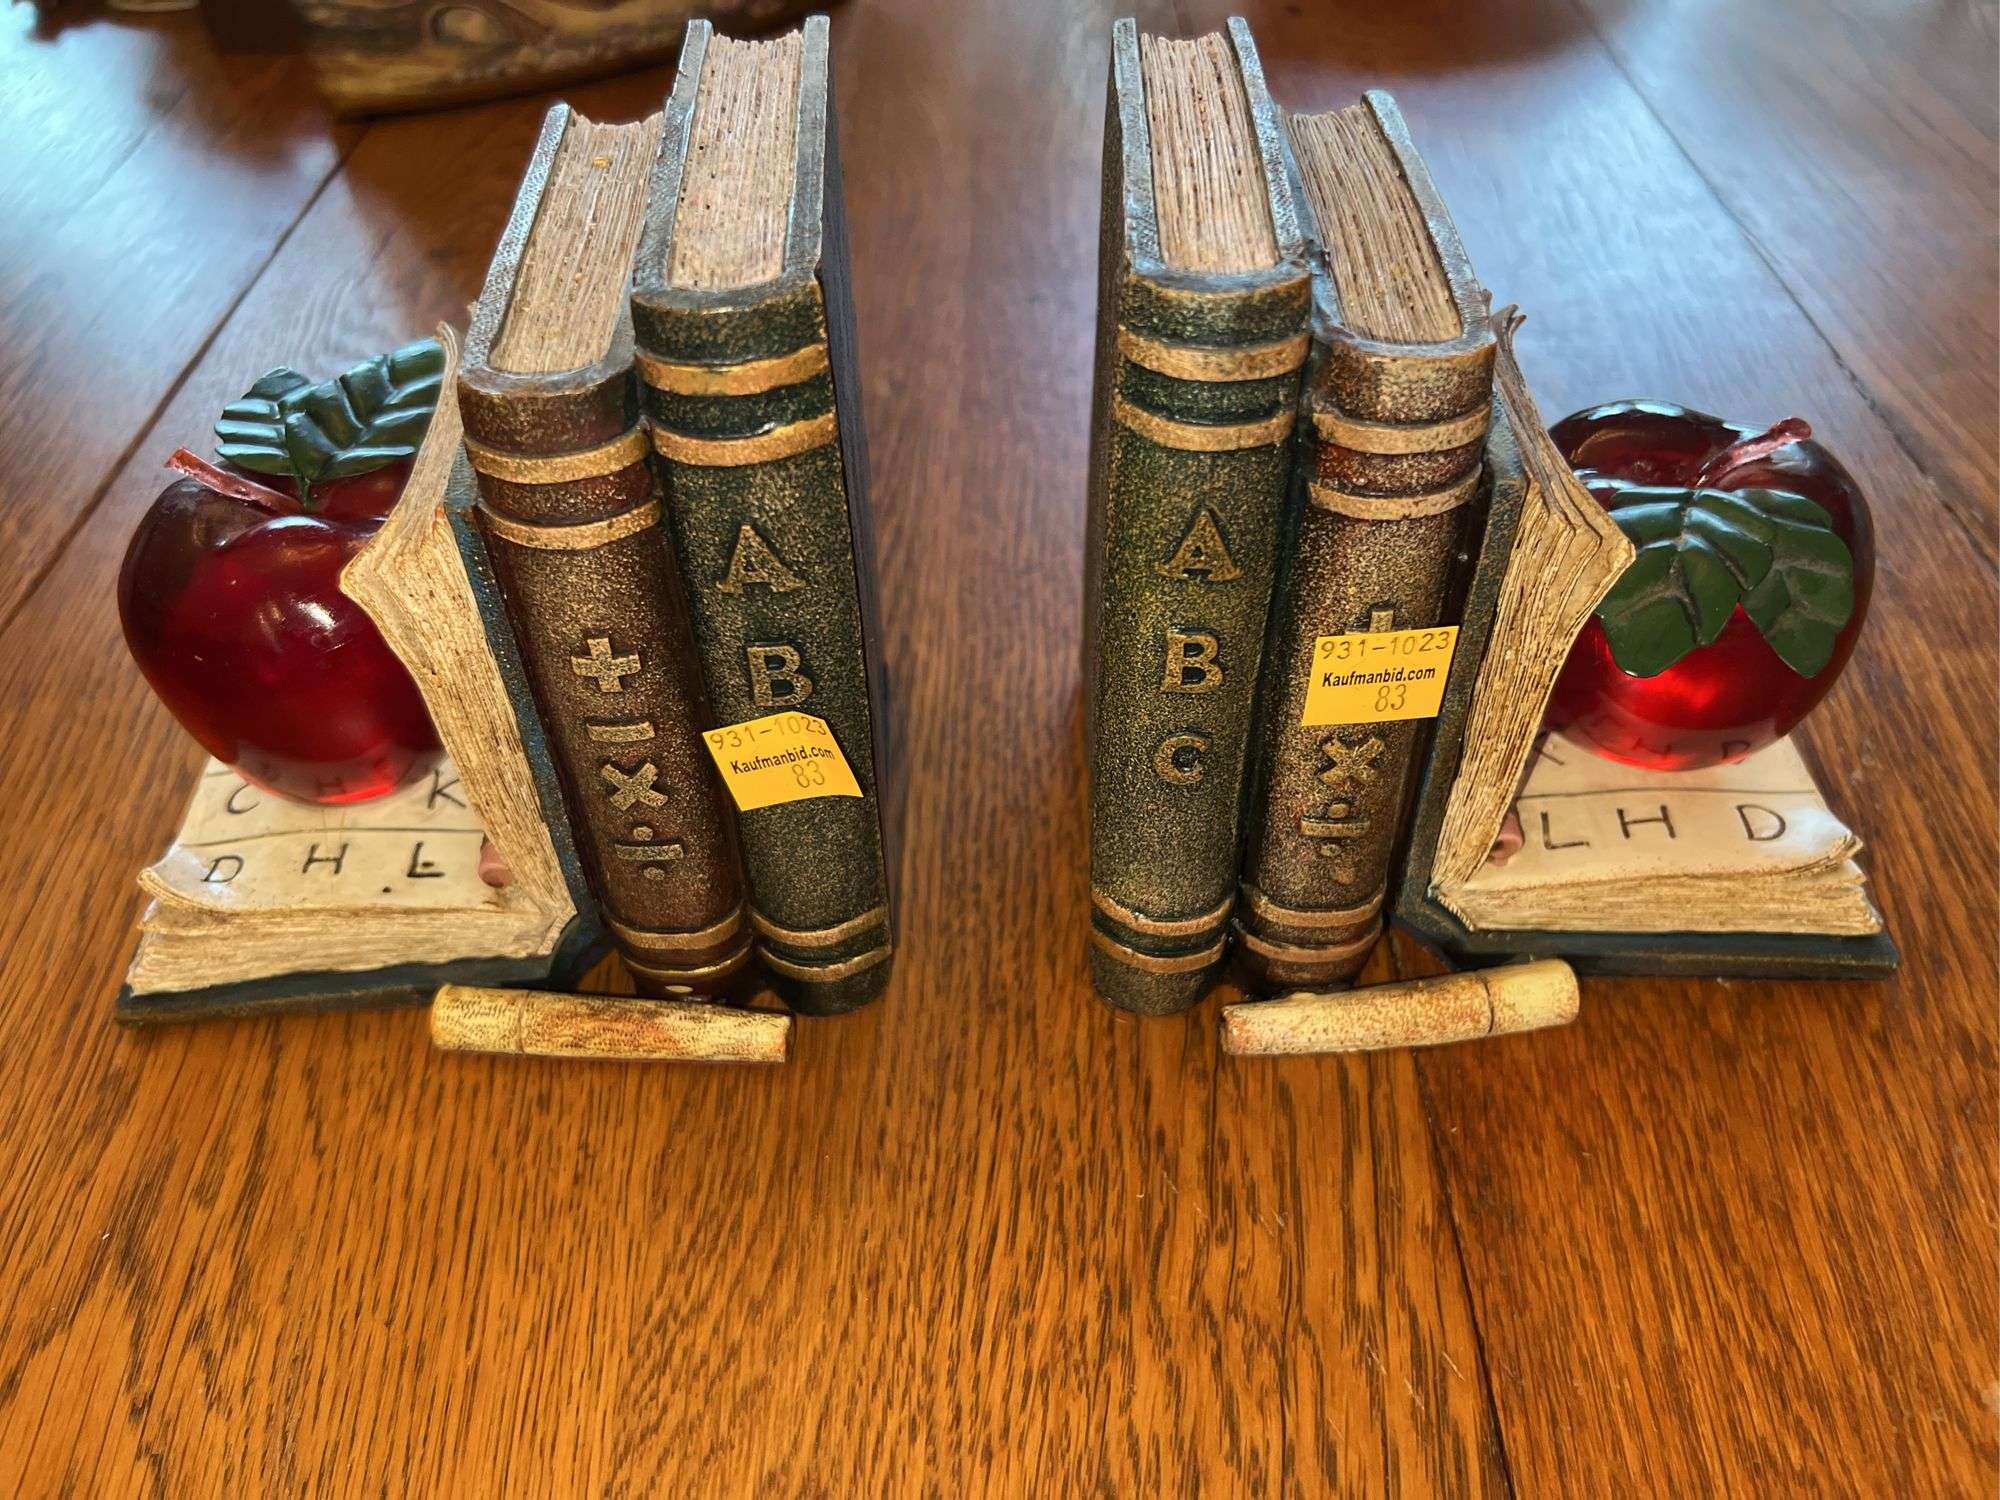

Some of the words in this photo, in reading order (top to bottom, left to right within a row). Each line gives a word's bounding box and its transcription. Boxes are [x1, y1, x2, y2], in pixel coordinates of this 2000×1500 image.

[716, 524, 806, 593] A
[1156, 510, 1241, 582] A
[1161, 629, 1225, 694] B
[1321, 631, 1450, 660] 931-1023
[747, 644, 812, 707] B
[1322, 666, 1436, 688] Kaufmanbid.com
[1374, 683, 1407, 712] 83
[730, 744, 835, 775] Kaufmanbid.com
[792, 760, 825, 788] 83
[1156, 735, 1209, 785] C
[1540, 811, 1589, 850] L
[1616, 804, 1677, 839] H
[1736, 803, 1786, 841] D
[202, 855, 245, 884] D
[302, 843, 349, 875] H
